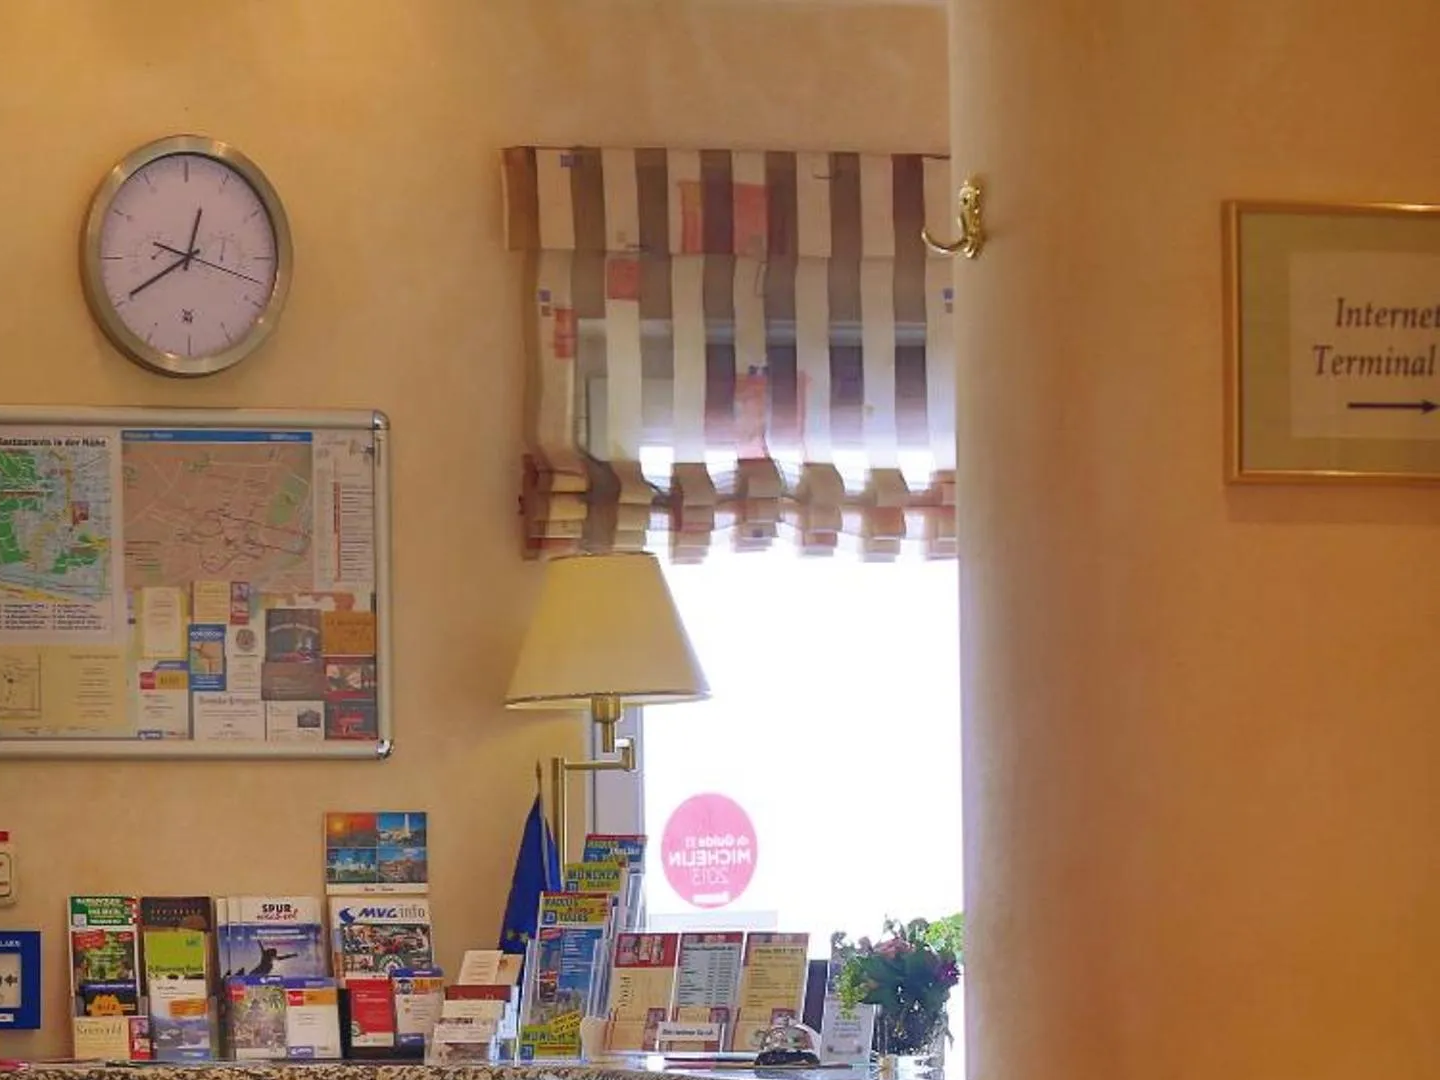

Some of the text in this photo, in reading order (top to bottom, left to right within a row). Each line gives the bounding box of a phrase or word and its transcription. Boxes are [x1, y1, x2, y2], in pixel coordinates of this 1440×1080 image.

[1335, 297, 1440, 328] Internet
[1312, 344, 1436, 377] Terminal
[262, 903, 292, 914] SPUR
[358, 907, 399, 918] MVG
